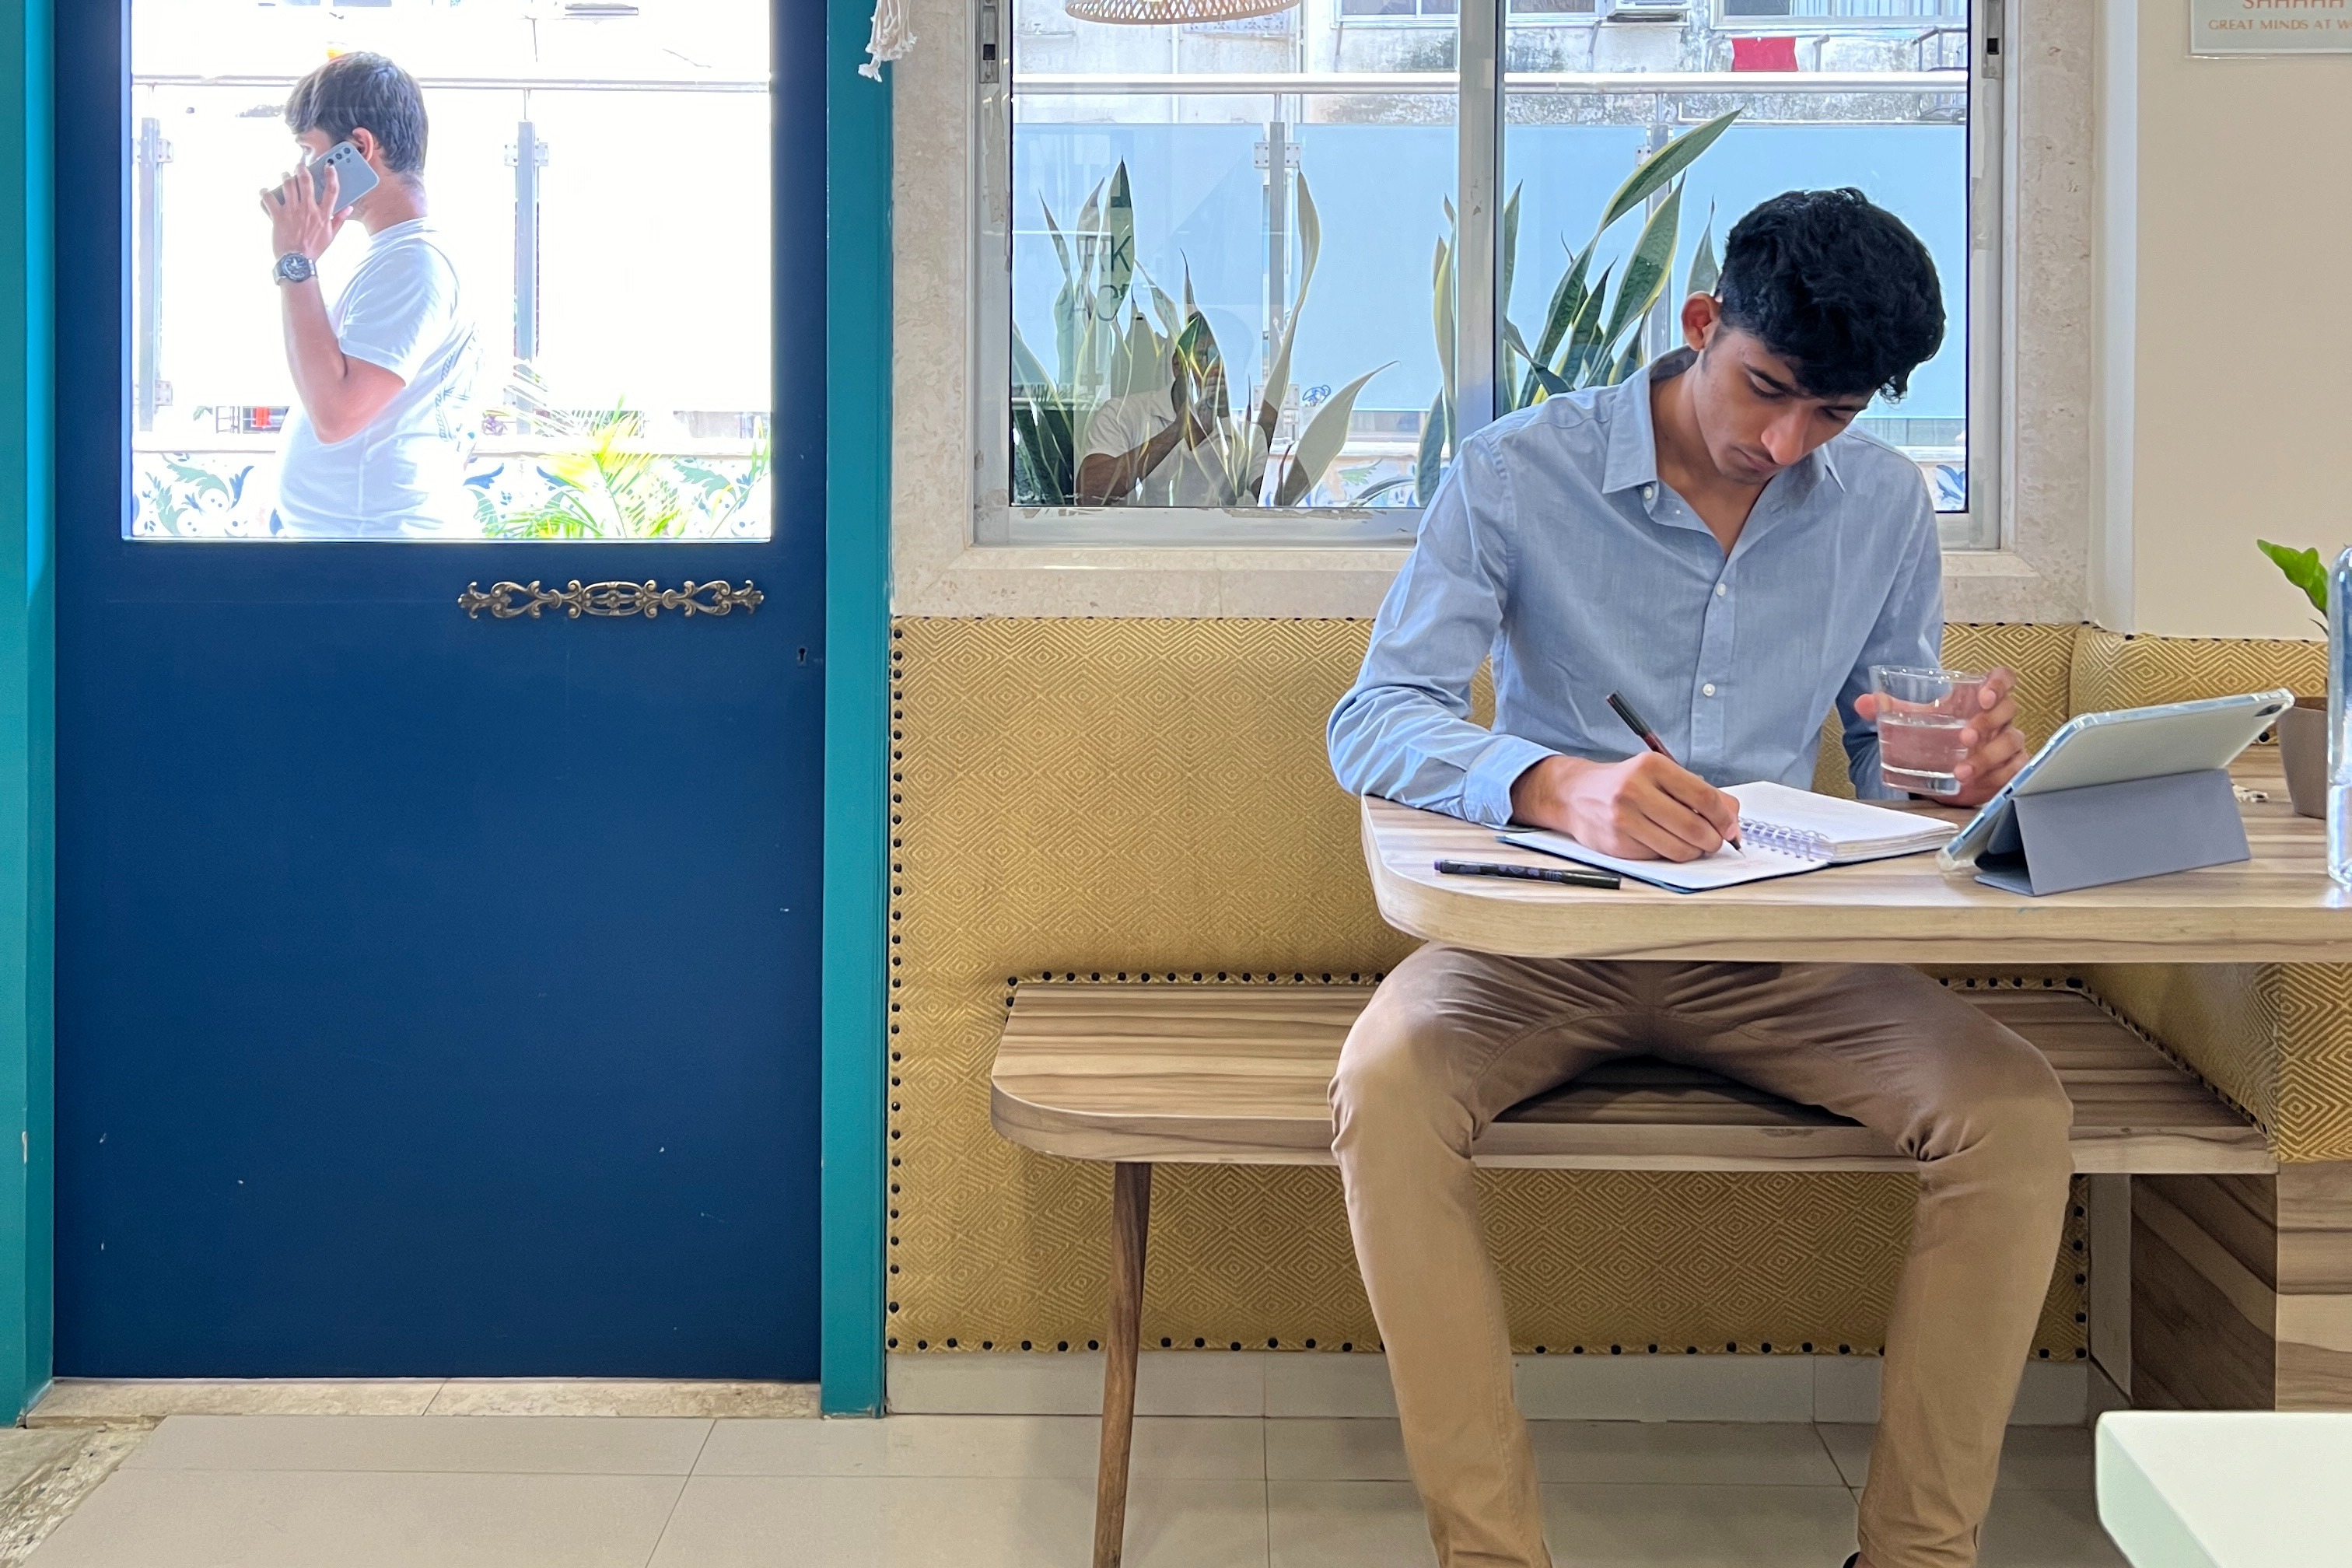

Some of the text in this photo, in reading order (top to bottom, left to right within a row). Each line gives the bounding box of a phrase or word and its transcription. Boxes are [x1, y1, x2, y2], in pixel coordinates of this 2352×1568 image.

[2209, 19, 2253, 30] GREAT
[2260, 19, 2308, 30] MINDS
[2315, 19, 2330, 30] AT
